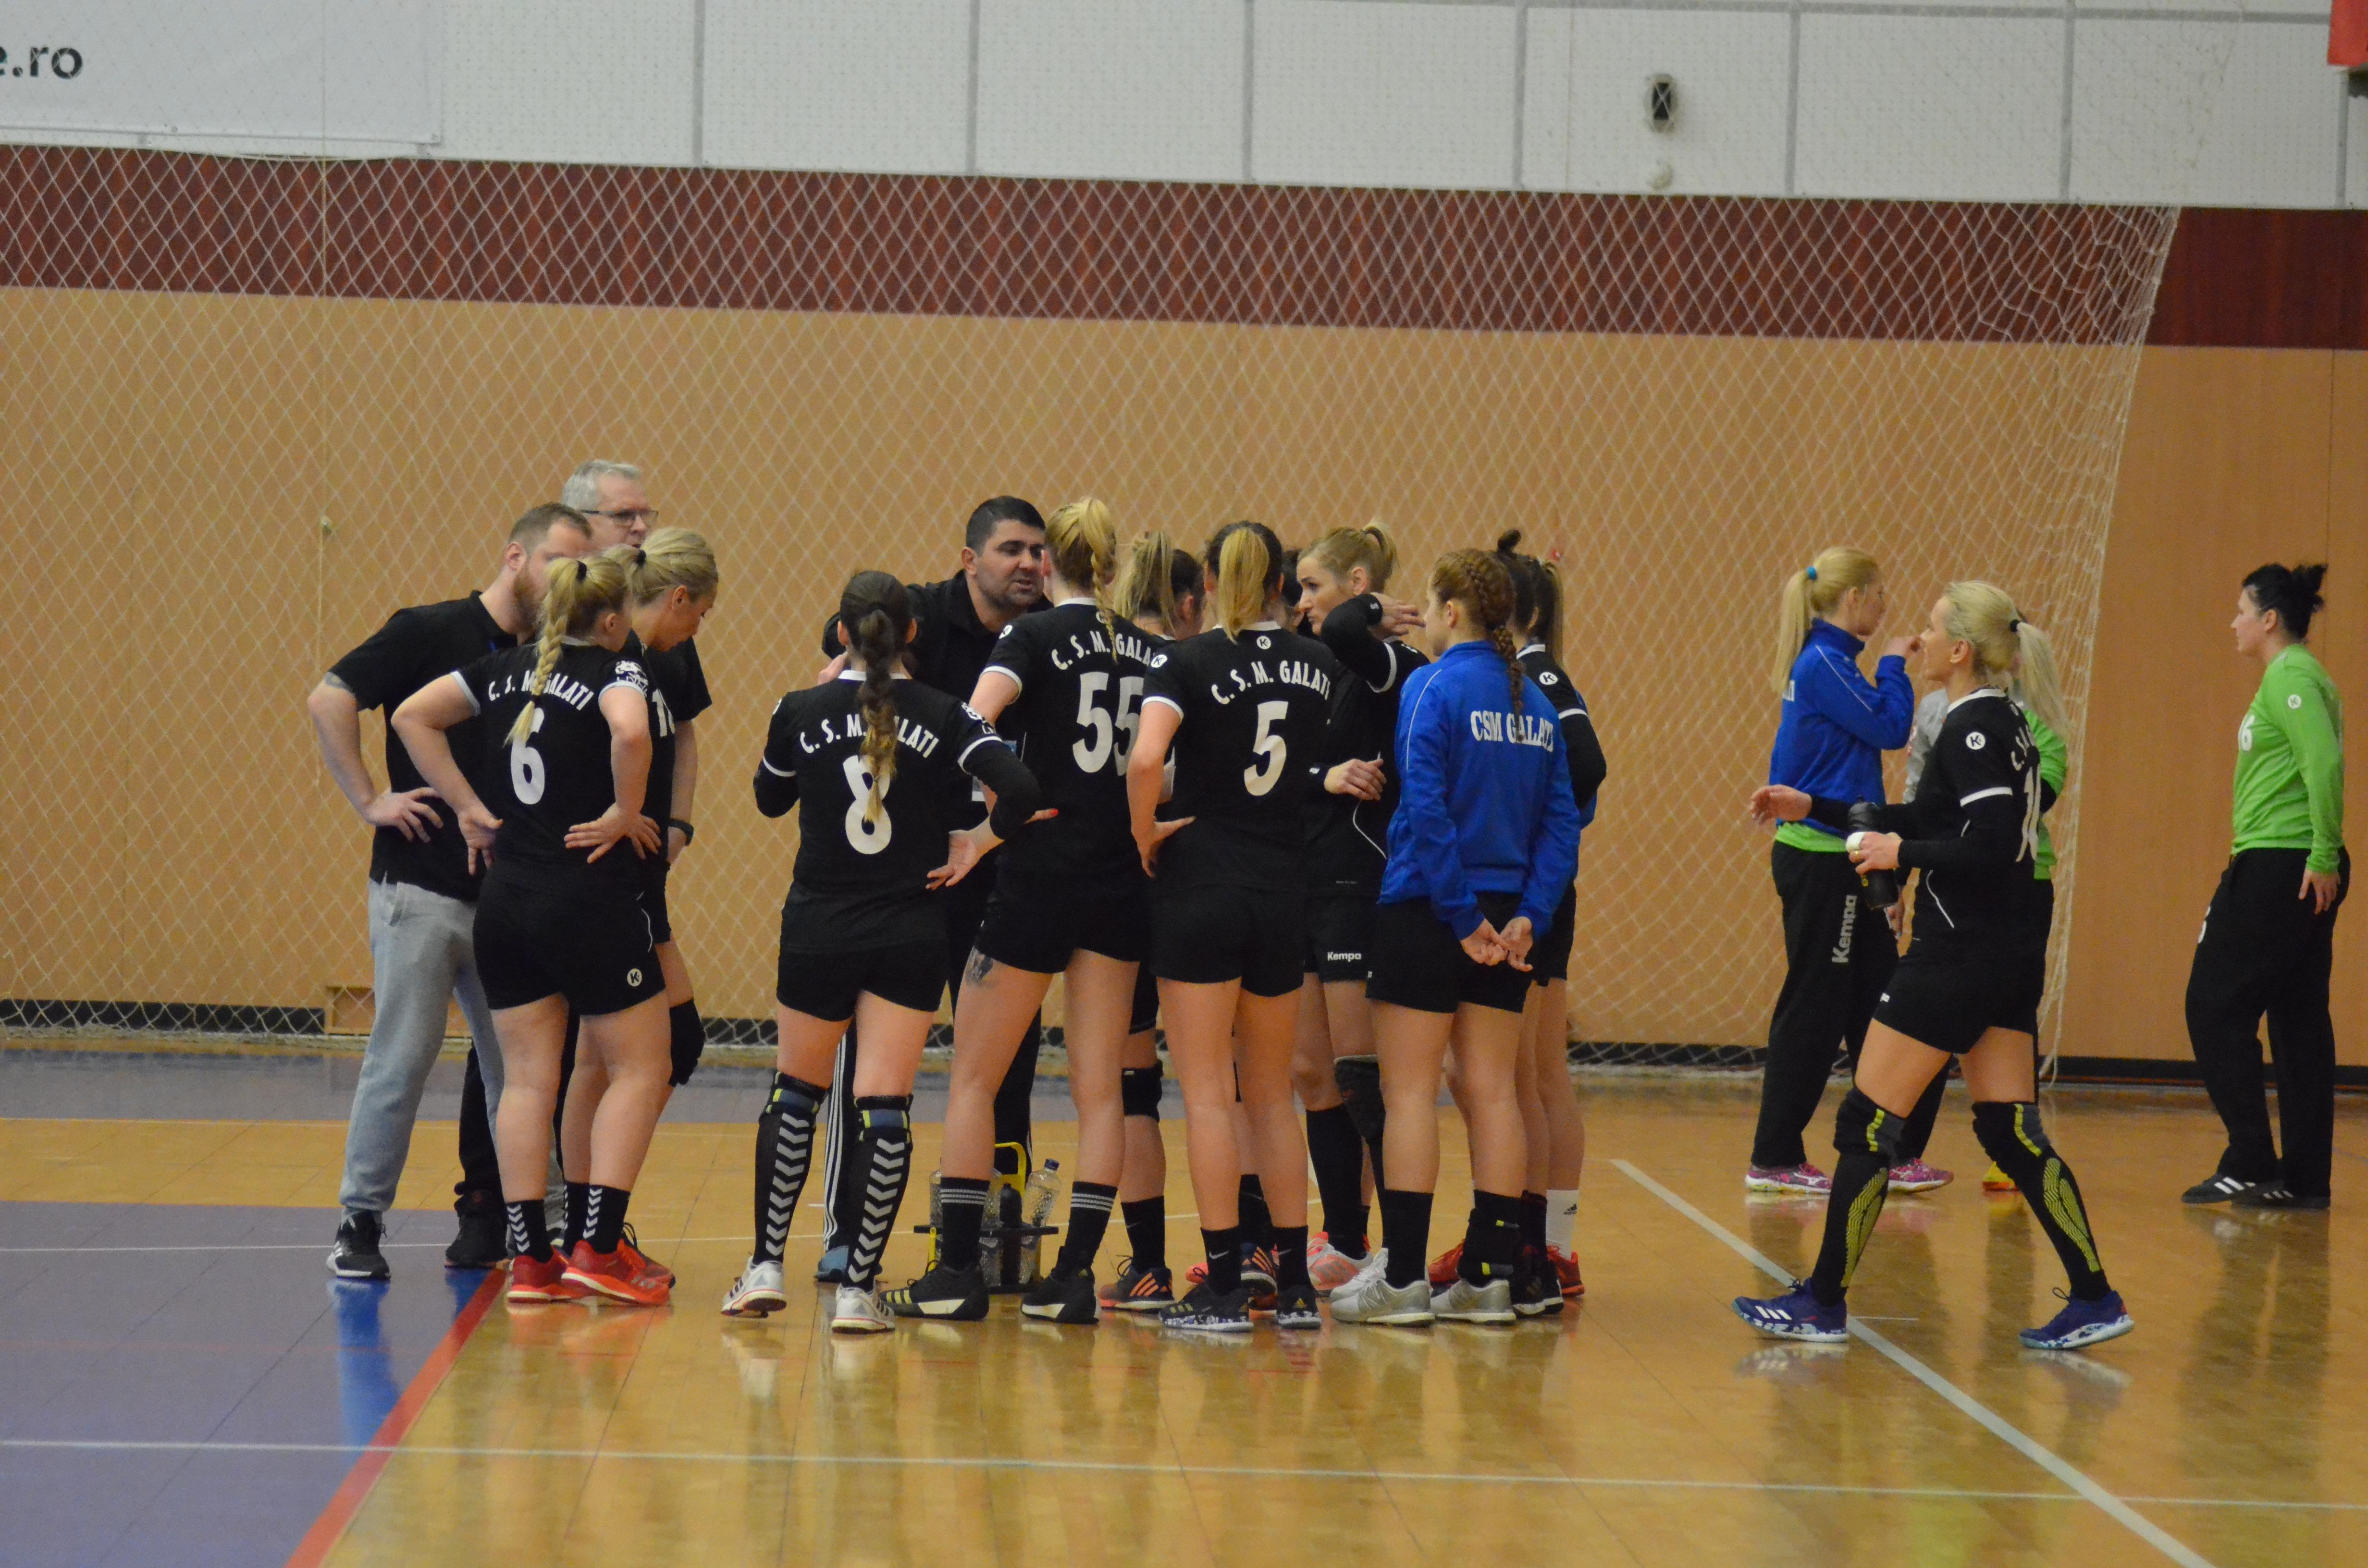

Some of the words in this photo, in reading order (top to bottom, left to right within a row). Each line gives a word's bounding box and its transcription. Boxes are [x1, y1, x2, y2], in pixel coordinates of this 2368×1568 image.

[0, 47, 83, 79] .ro
[1051, 649, 1073, 671] C.
[1070, 635, 1090, 659] S.
[1089, 630, 1110, 653] M.
[1211, 684, 1235, 705] C.
[1230, 669, 1252, 692] S.
[1251, 661, 1274, 685] M.
[1279, 660, 1331, 700] GALATI
[800, 732, 820, 754] C.
[821, 719, 841, 744] S.
[847, 713, 866, 737] M.
[1072, 671, 1145, 777] 55
[1470, 710, 1504, 742] CSM
[510, 707, 545, 805] 6
[1244, 700, 1289, 796] 5
[842, 755, 892, 855] 8
[1831, 894, 1858, 963] Kempa
[1327, 951, 1362, 962] Kempa
